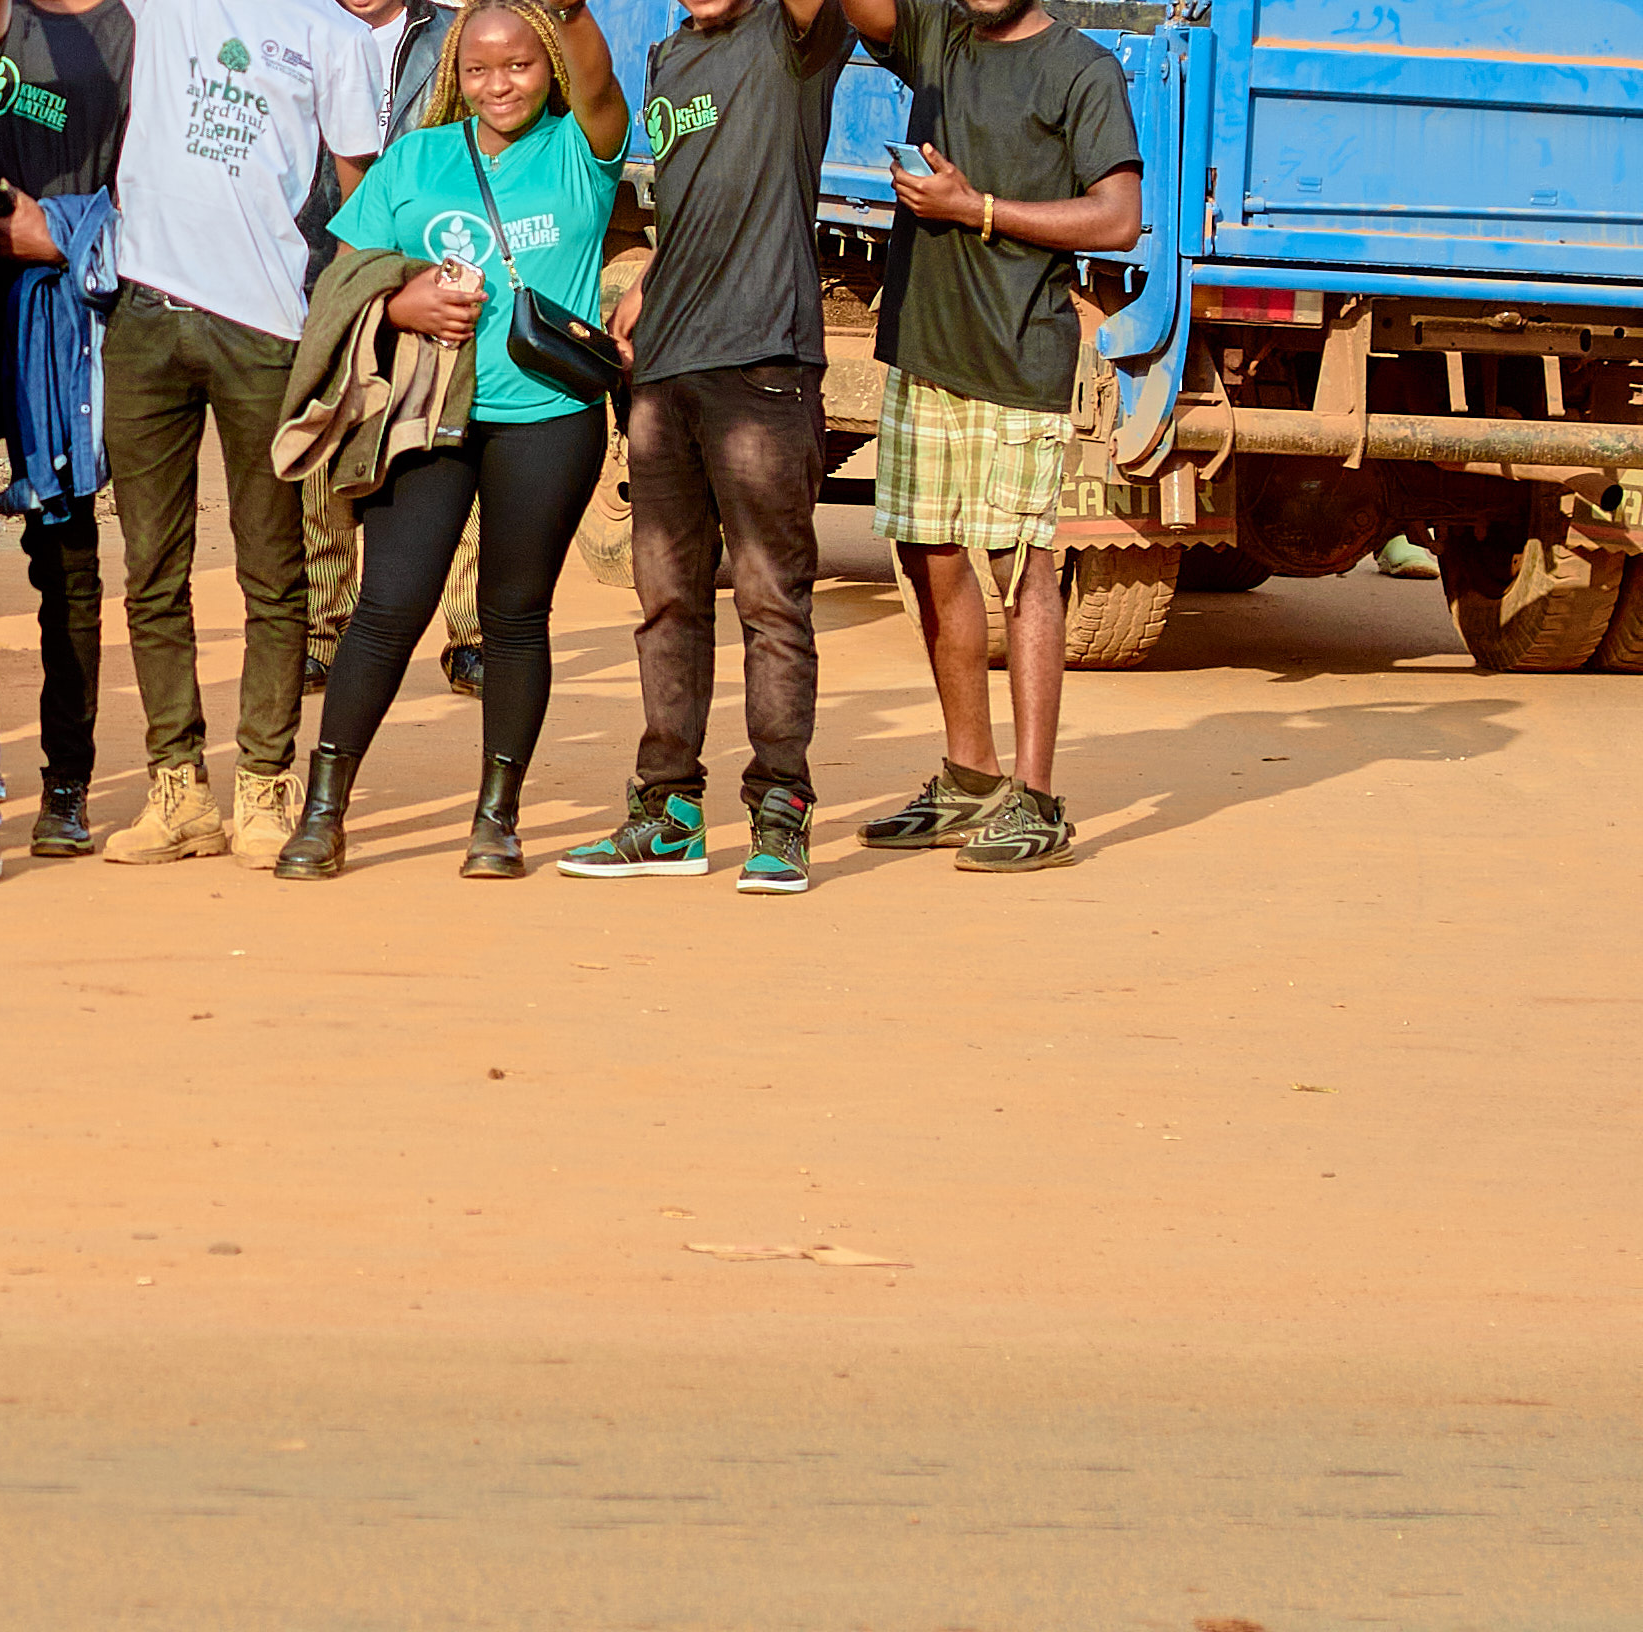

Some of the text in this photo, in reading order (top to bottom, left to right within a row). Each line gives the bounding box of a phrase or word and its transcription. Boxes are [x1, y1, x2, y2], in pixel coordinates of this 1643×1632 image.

[15, 96, 68, 130] NATURE
[20, 82, 67, 112] KWETU
[202, 76, 270, 116] rbre
[508, 227, 561, 251] ATURE
[1058, 480, 1218, 519] CANTR
